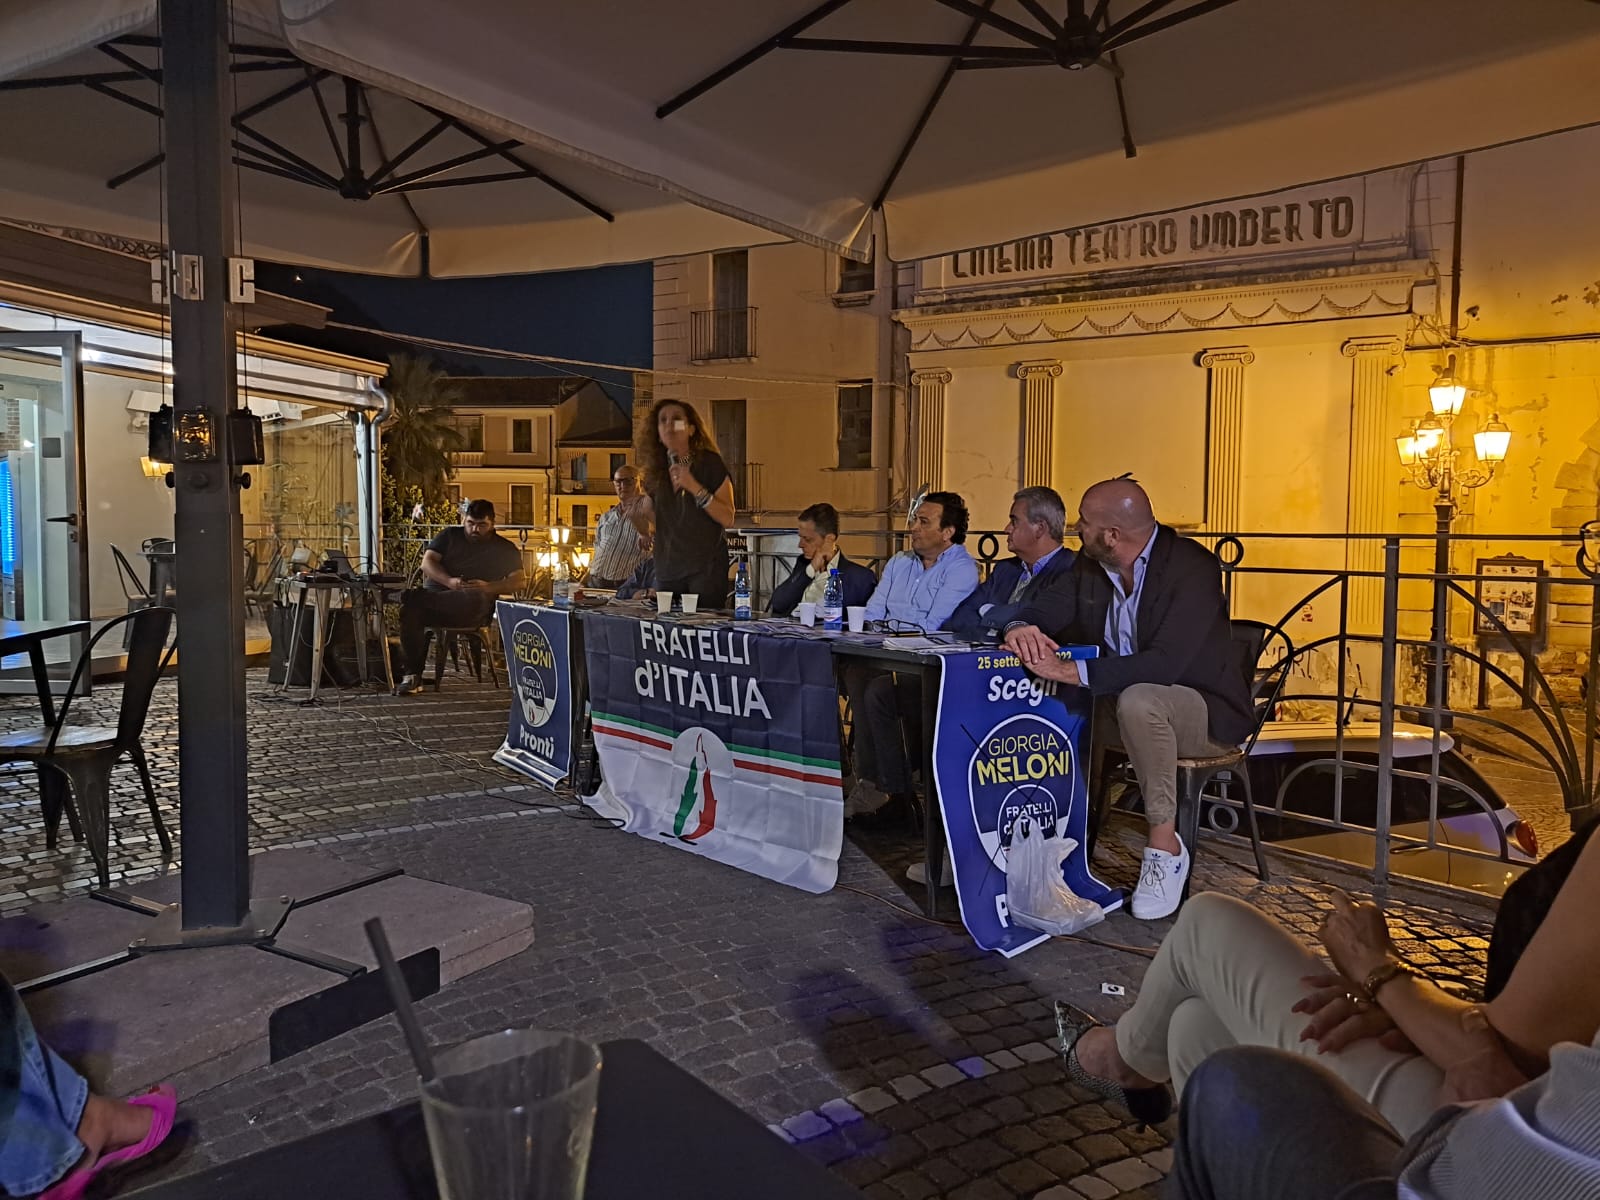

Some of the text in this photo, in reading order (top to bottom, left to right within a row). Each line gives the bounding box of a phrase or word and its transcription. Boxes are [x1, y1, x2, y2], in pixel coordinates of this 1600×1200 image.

[1064, 216, 1177, 266] TEATRO
[1190, 196, 1353, 249] UMBERTO
[515, 630, 547, 649] GIORGIA
[639, 620, 750, 665] FRATELLI
[514, 643, 552, 670] MELONI
[977, 656, 991, 669] 25
[993, 655, 1021, 669] sette
[634, 659, 772, 720] d'ITALIA
[519, 723, 555, 760] Pronti
[988, 732, 1060, 756] GIORGIA
[976, 750, 1070, 786] MELONI
[1005, 801, 1053, 818] FRATELLI
